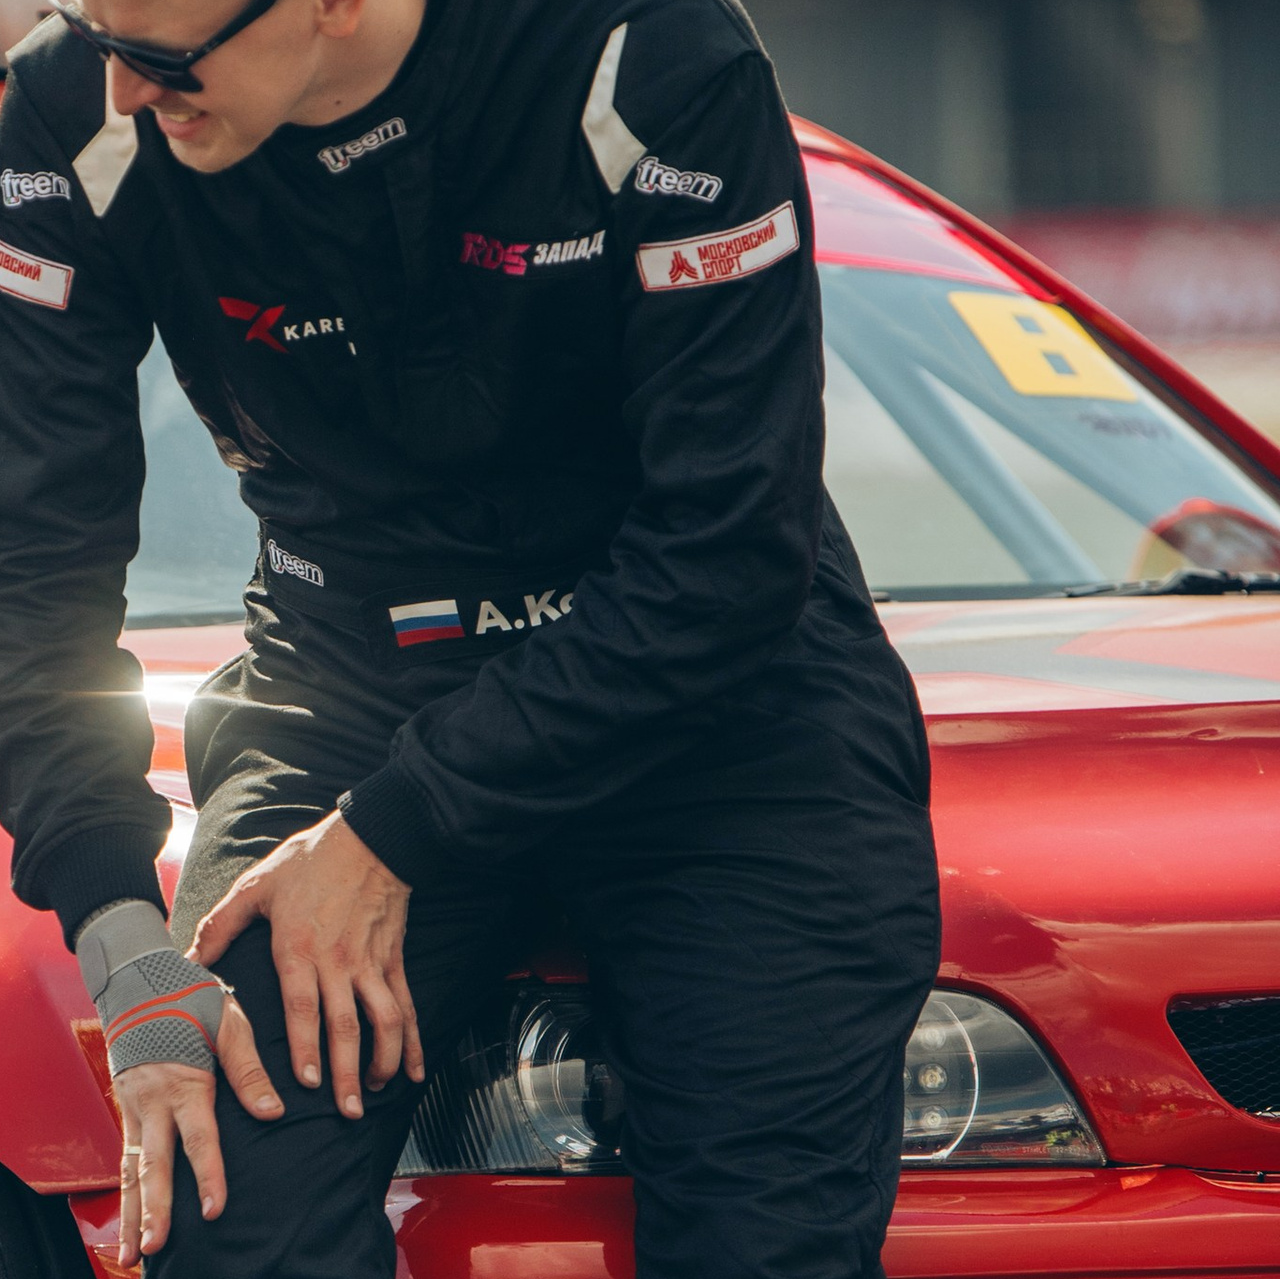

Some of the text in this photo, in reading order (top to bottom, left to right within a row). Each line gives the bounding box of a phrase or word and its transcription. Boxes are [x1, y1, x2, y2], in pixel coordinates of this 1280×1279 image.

[318, 118, 406, 172] freem
[636, 157, 721, 201] freem
[460, 230, 606, 276] RDS ЗАПАД
[697, 220, 777, 263] МОСКОВСКИЙ
[701, 254, 743, 280] СПОРТ
[268, 539, 324, 587] freem
